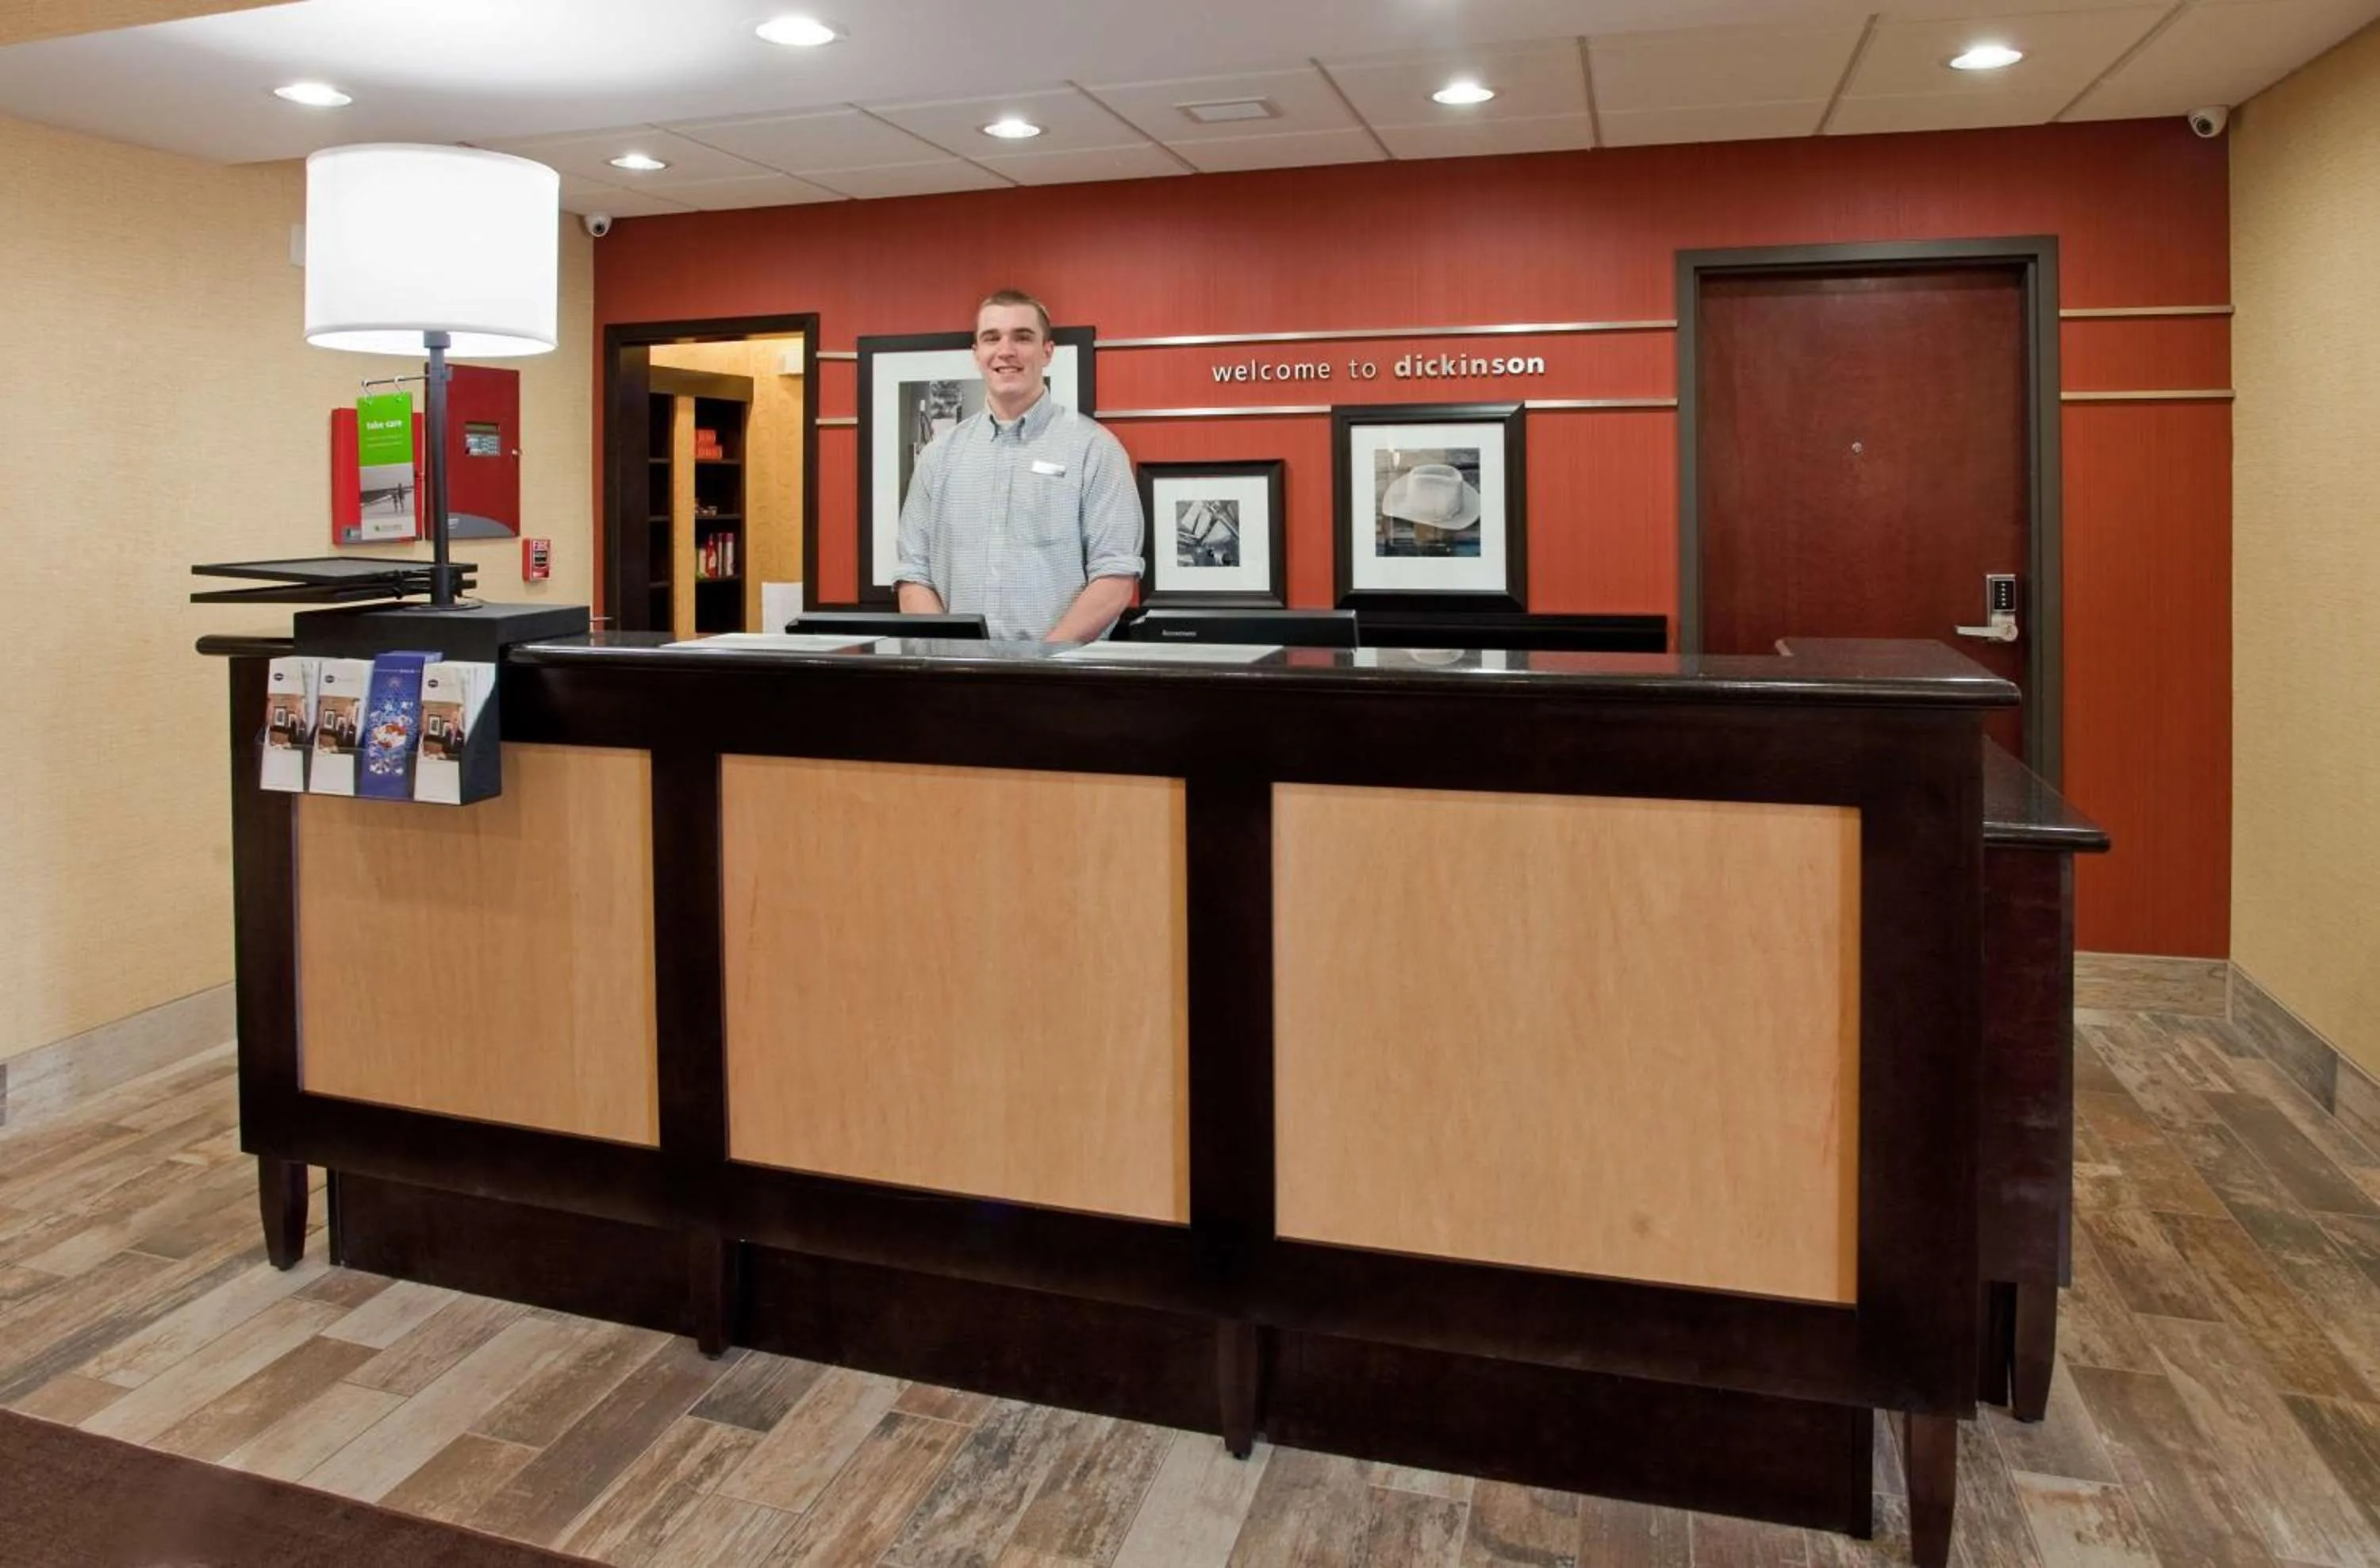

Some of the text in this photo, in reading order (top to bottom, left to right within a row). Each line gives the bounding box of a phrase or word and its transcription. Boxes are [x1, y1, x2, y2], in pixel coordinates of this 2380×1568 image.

[1212, 354, 1545, 382] welcome to dickinson
